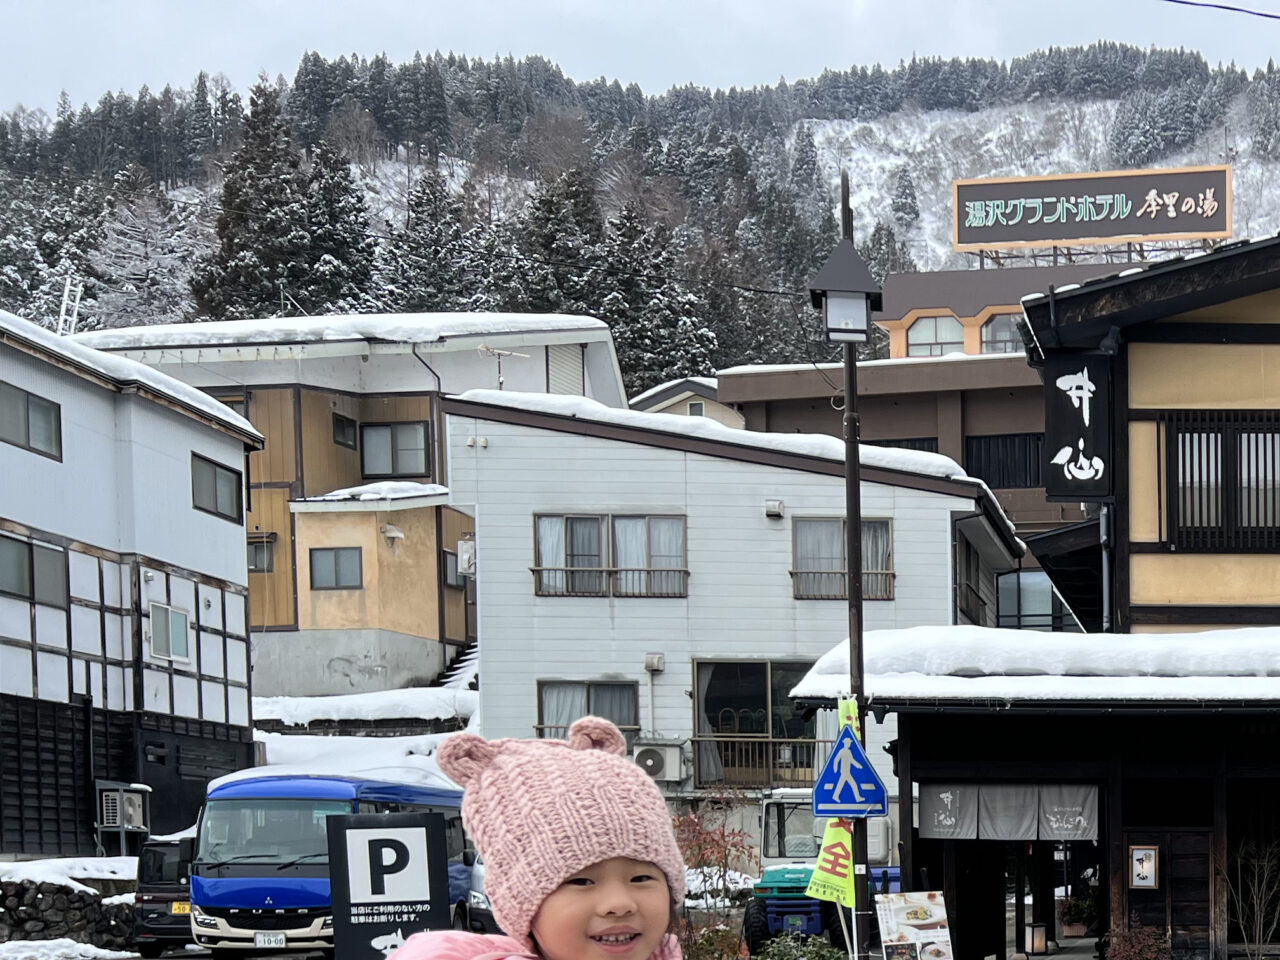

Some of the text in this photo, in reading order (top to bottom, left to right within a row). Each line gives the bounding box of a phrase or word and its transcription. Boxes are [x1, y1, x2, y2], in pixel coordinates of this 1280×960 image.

[965, 193, 1132, 228] 湯沢グランドホテル
[1050, 366, 1105, 480] 井仙
[368, 838, 410, 896] P
[350, 904, 430, 915] 当店にご利用のない方の
[350, 913, 420, 924] 駐車はお断りします。
